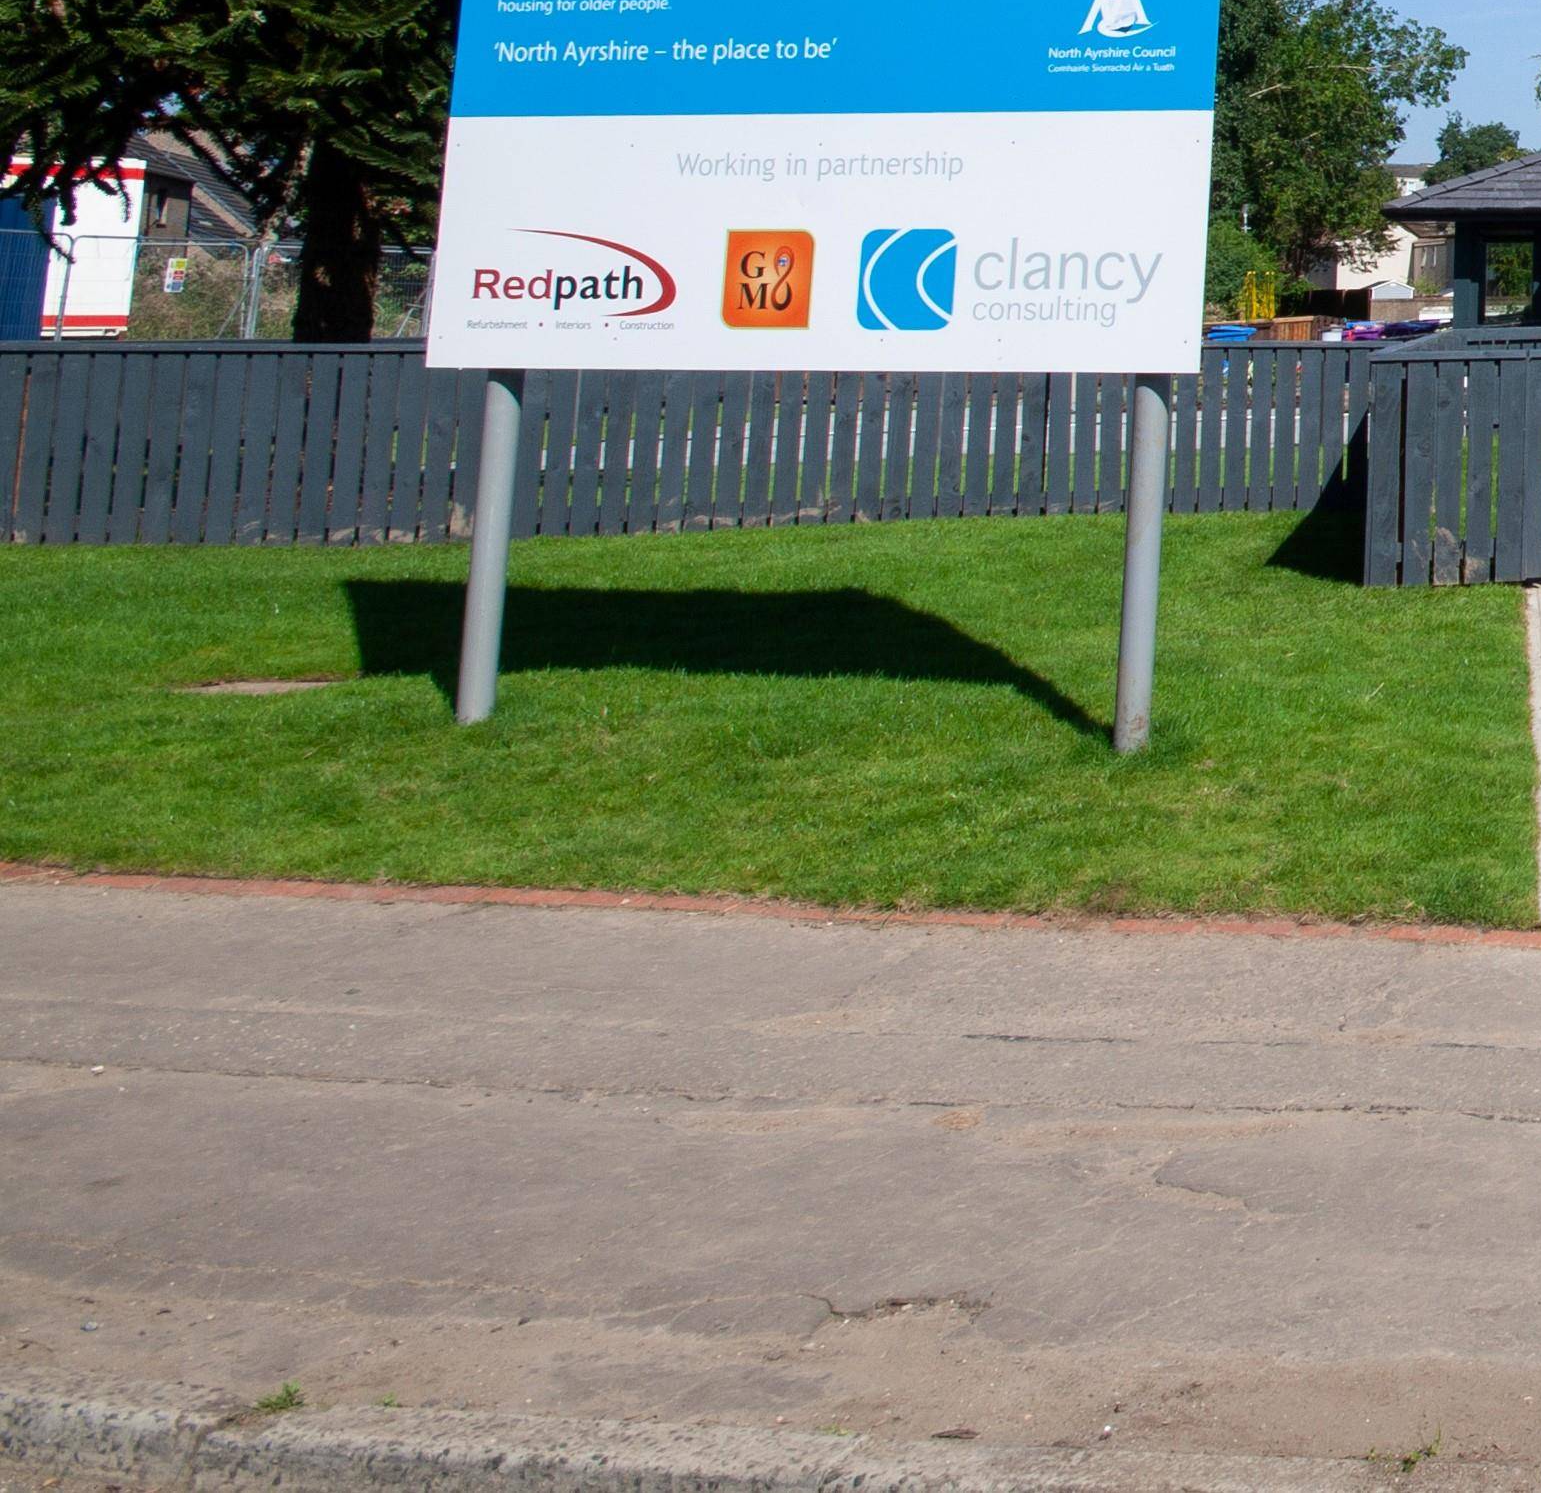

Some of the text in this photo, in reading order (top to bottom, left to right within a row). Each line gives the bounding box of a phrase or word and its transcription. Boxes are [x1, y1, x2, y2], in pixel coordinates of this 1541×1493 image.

[562, 39, 649, 67] Ayrshire
[672, 38, 708, 61] the
[712, 37, 770, 65] place
[775, 40, 798, 60] to
[1048, 45, 1177, 61] North Ayrshire Council
[677, 151, 963, 182] Working in partnership
[974, 237, 1162, 303] clancy
[471, 265, 643, 310] Redpath
[466, 319, 528, 330] Refurbishment
[555, 320, 592, 330] Interiors
[619, 320, 675, 331] Construction
[973, 296, 1116, 328] consulting
